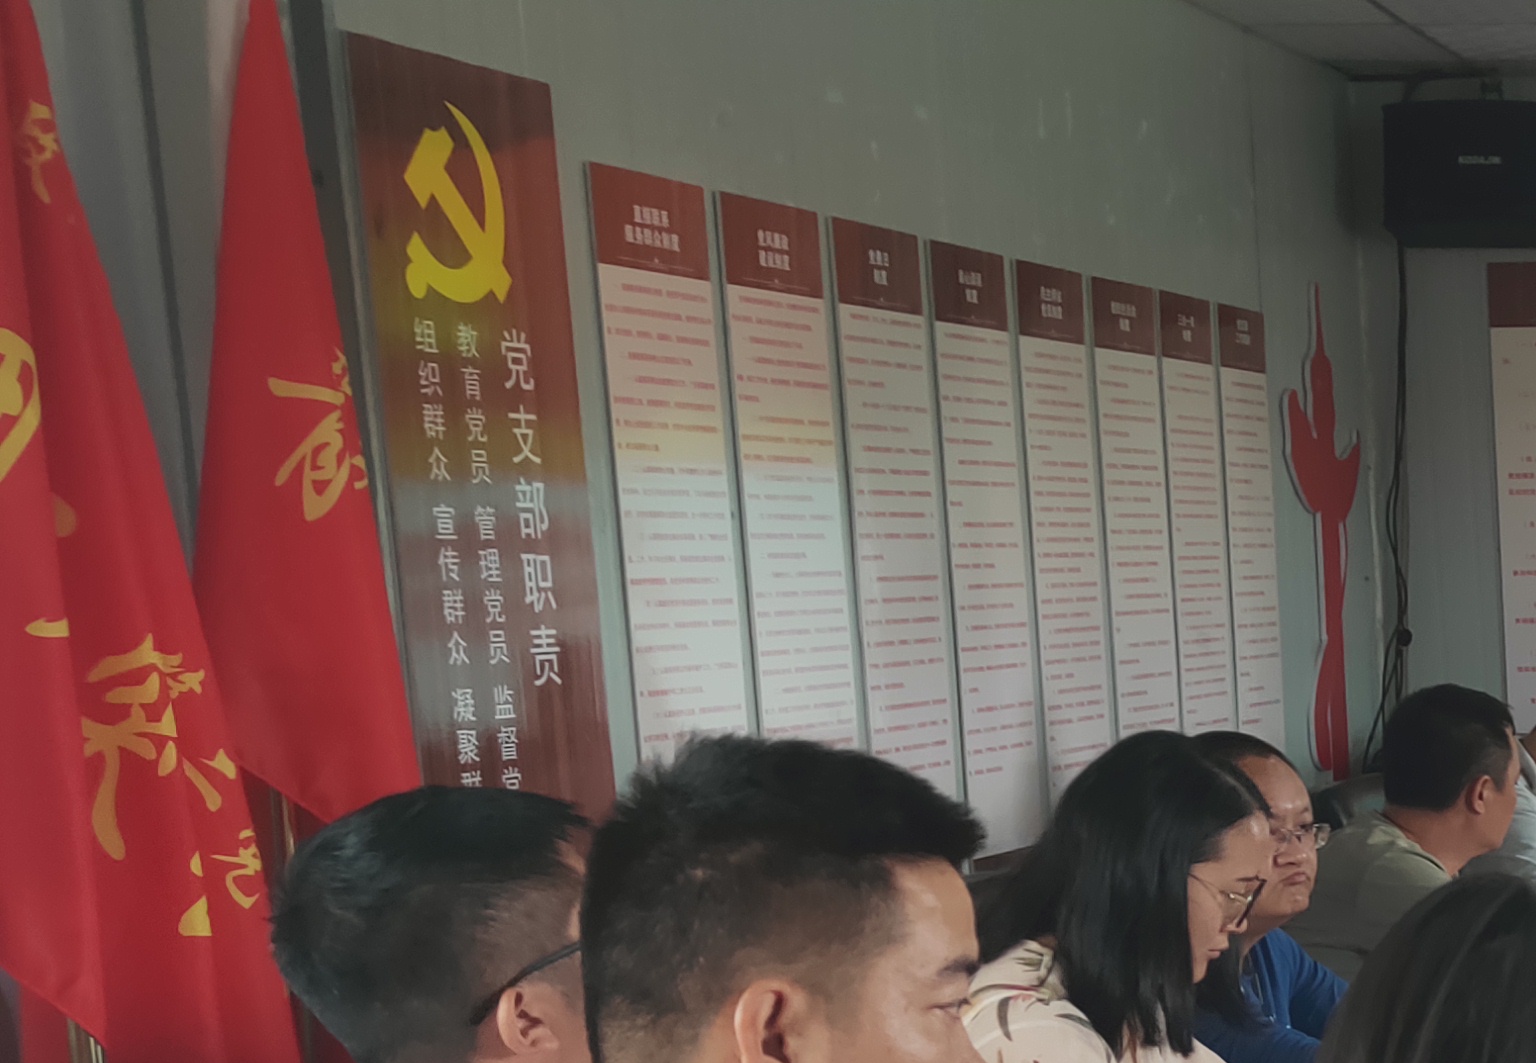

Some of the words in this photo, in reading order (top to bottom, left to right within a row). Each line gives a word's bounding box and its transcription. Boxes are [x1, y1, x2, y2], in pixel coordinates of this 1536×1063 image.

[414, 316, 452, 482] 组织群众
[456, 322, 492, 484] 教育党员
[474, 504, 510, 664] 管理党员
[500, 328, 562, 686] 党支部职责
[432, 503, 470, 666] 宣传群众
